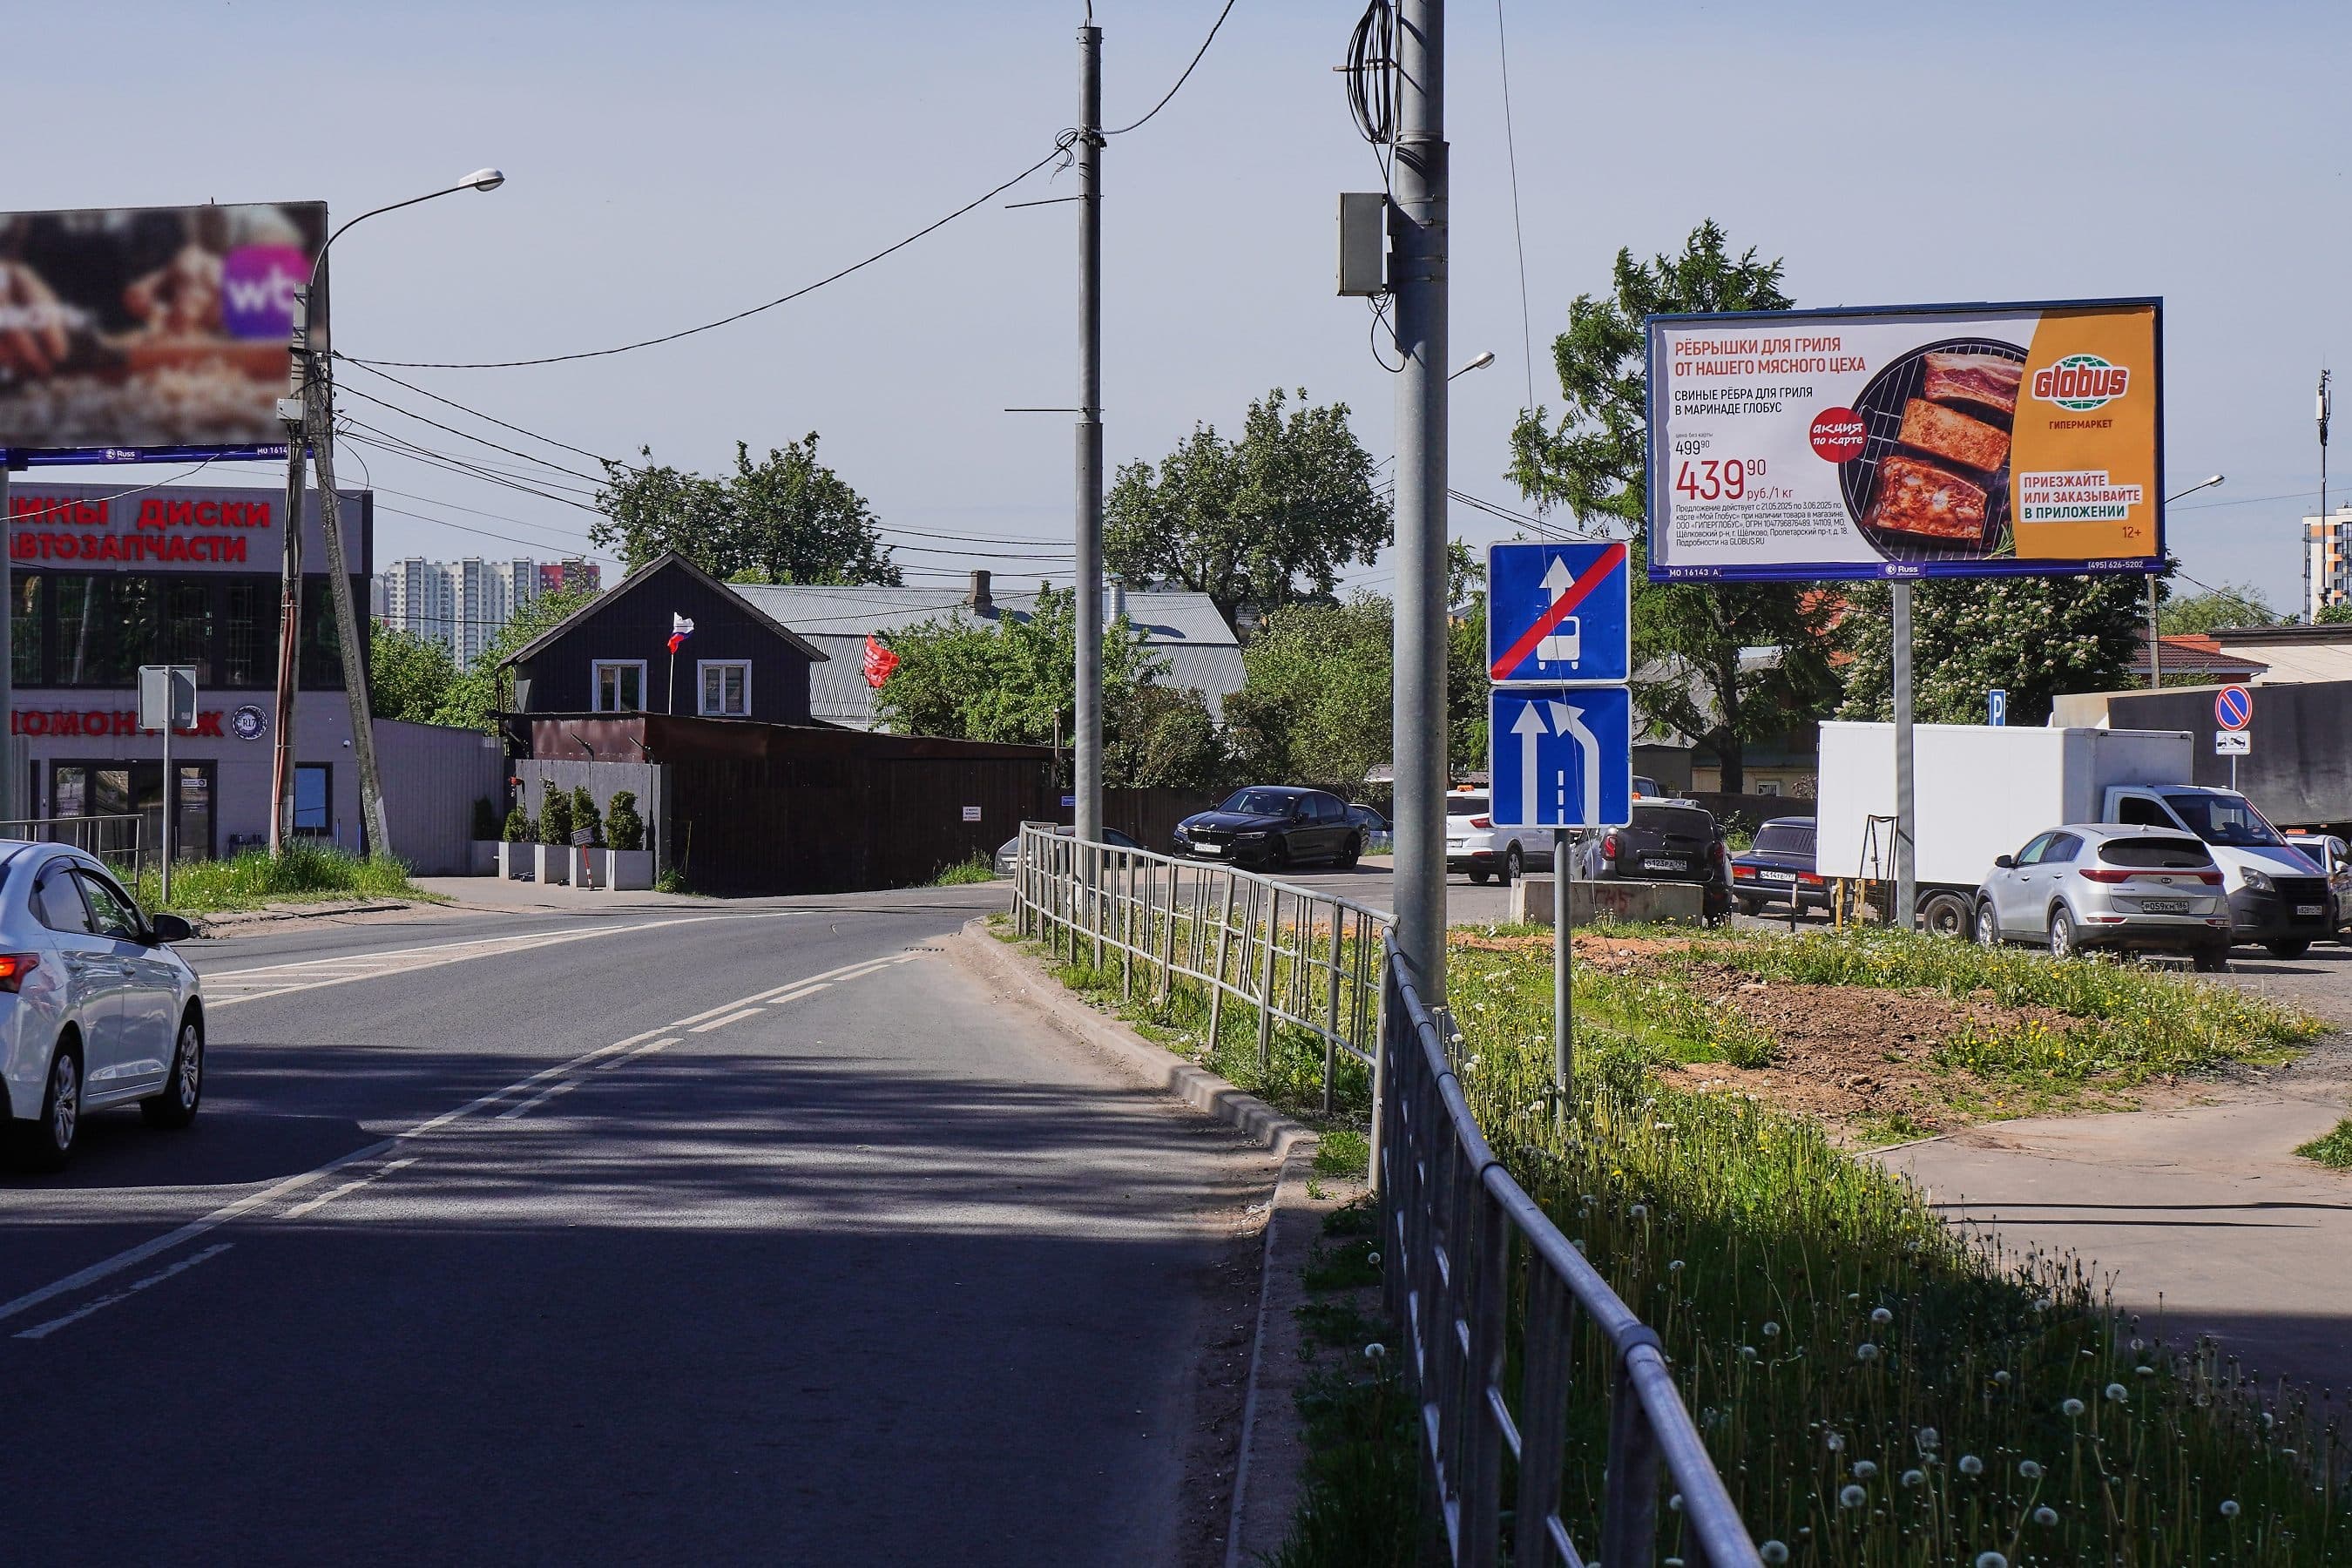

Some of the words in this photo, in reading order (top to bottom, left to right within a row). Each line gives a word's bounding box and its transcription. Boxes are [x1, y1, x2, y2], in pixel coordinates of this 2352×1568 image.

[1675, 338, 1758, 356] РЁБРЫШКИ
[1761, 339, 1791, 355] ДЛЯ
[1795, 337, 1841, 352] ГРИЛЯ
[1675, 362, 1693, 376] ОТ
[1696, 360, 1754, 375] НАШЕГО
[1758, 358, 1826, 374] МЯСНОГО
[1829, 357, 1866, 374] ЦЕХА
[2035, 364, 2127, 398] Globus
[1674, 389, 1718, 401] СВИНЫЕ
[1720, 386, 1754, 400] РЁБРА
[1755, 388, 1776, 400] ДЛЯ
[1780, 387, 1813, 398] ГРИЛЯ
[1675, 405, 1682, 415] В
[1685, 403, 1740, 416] МАРИНАДЕ
[1743, 402, 1782, 414] ГЛОБУС
[1813, 422, 1863, 435] акция
[2049, 419, 2113, 430] ГИПЕРМАРКЕТ
[1675, 440, 1700, 456] 499
[1828, 436, 1863, 447] карте
[1676, 459, 1744, 500] 439
[1747, 459, 1767, 476] 90
[2024, 472, 2105, 488] ПРИЕЗЖАЙТЕ
[1782, 490, 1794, 498] кг
[2024, 491, 2050, 504] ИЛИ
[2052, 487, 2140, 503] ЗАКАЗЫВАЙТЕ
[10, 496, 109, 524] ИНЫ
[137, 498, 272, 531] ДИСКИ
[2024, 508, 2032, 519] В
[2036, 505, 2126, 519] ПРИЛОЖЕНИИ
[1769, 528, 1816, 537] Пролетарский
[2122, 526, 2142, 538] 12+
[1676, 538, 1719, 547] Подробности
[2088, 561, 2107, 570] (495)
[2108, 560, 2143, 569] 626-5202
[1994, 695, 2003, 726] P
[10, 710, 225, 737] ОМОНЖ
